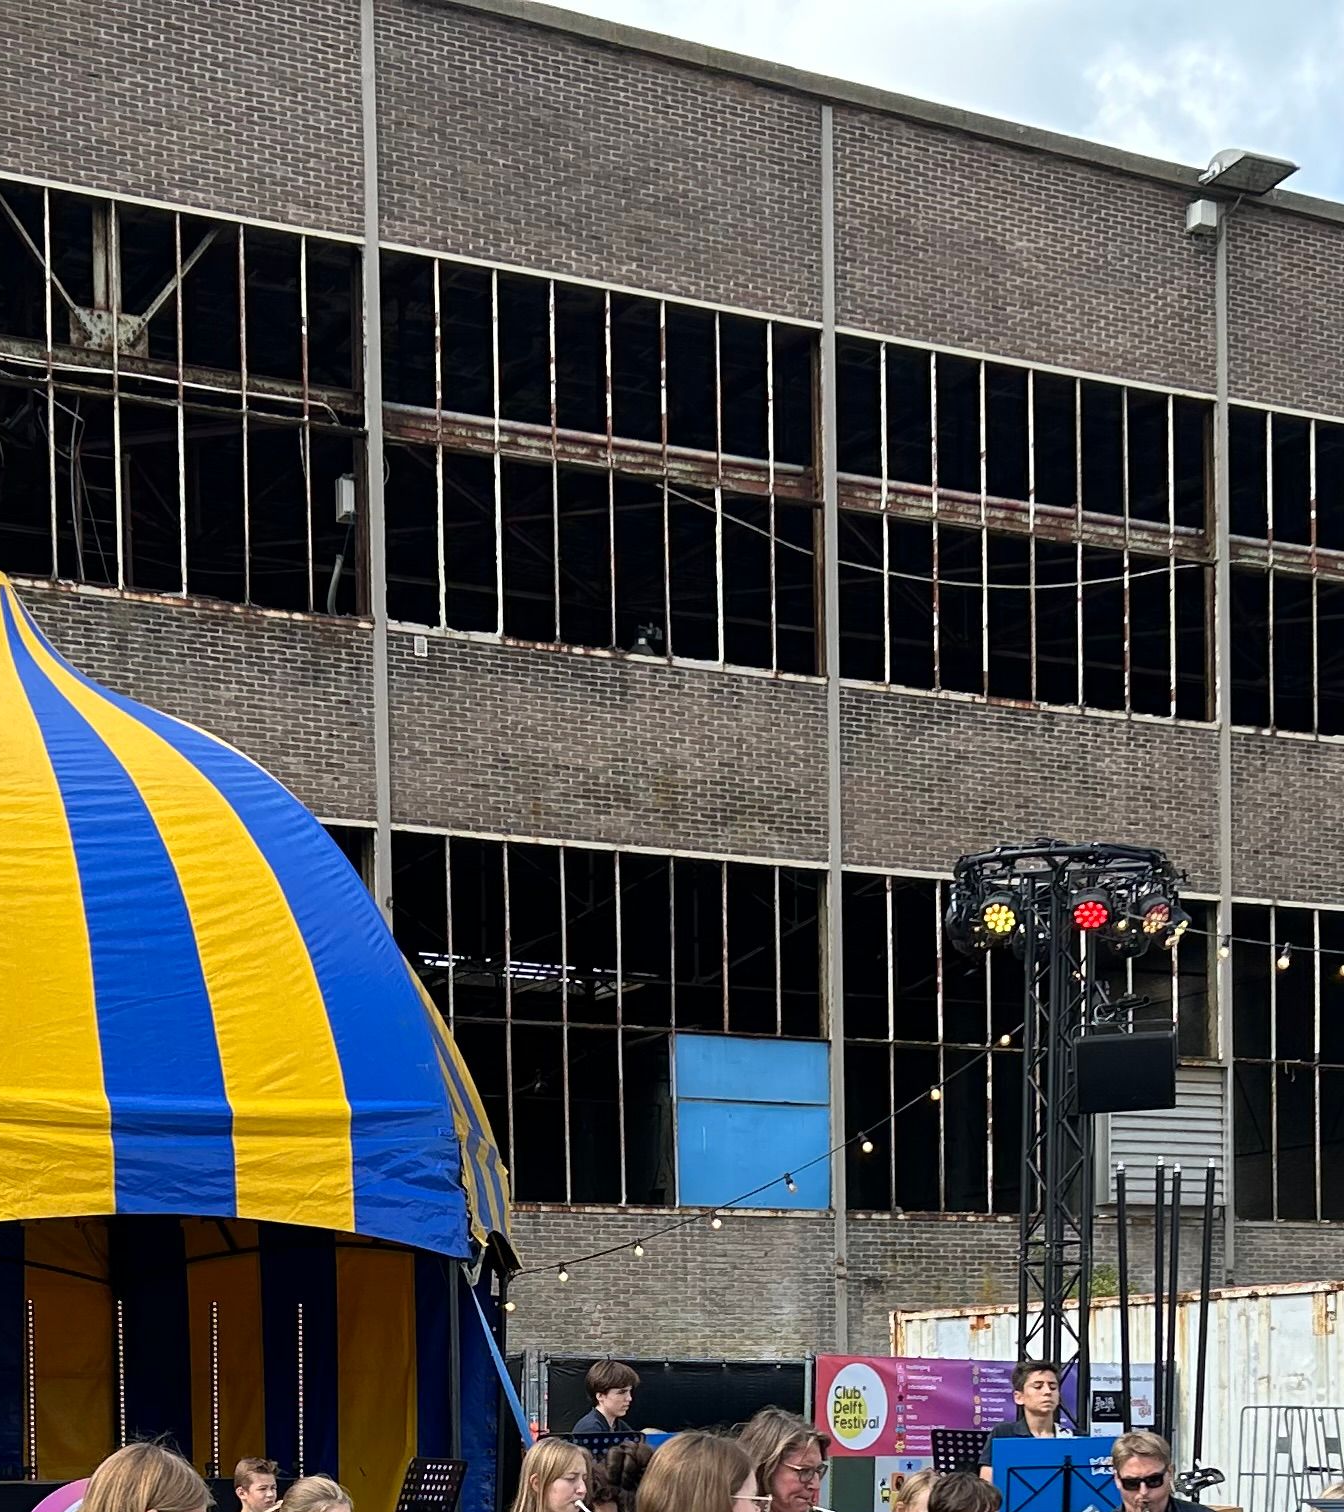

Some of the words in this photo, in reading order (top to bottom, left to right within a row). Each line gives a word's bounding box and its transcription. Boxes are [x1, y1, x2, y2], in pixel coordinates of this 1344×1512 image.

[834, 1385, 861, 1400] Club
[833, 1400, 864, 1415] Delft
[833, 1415, 880, 1430] Festival
